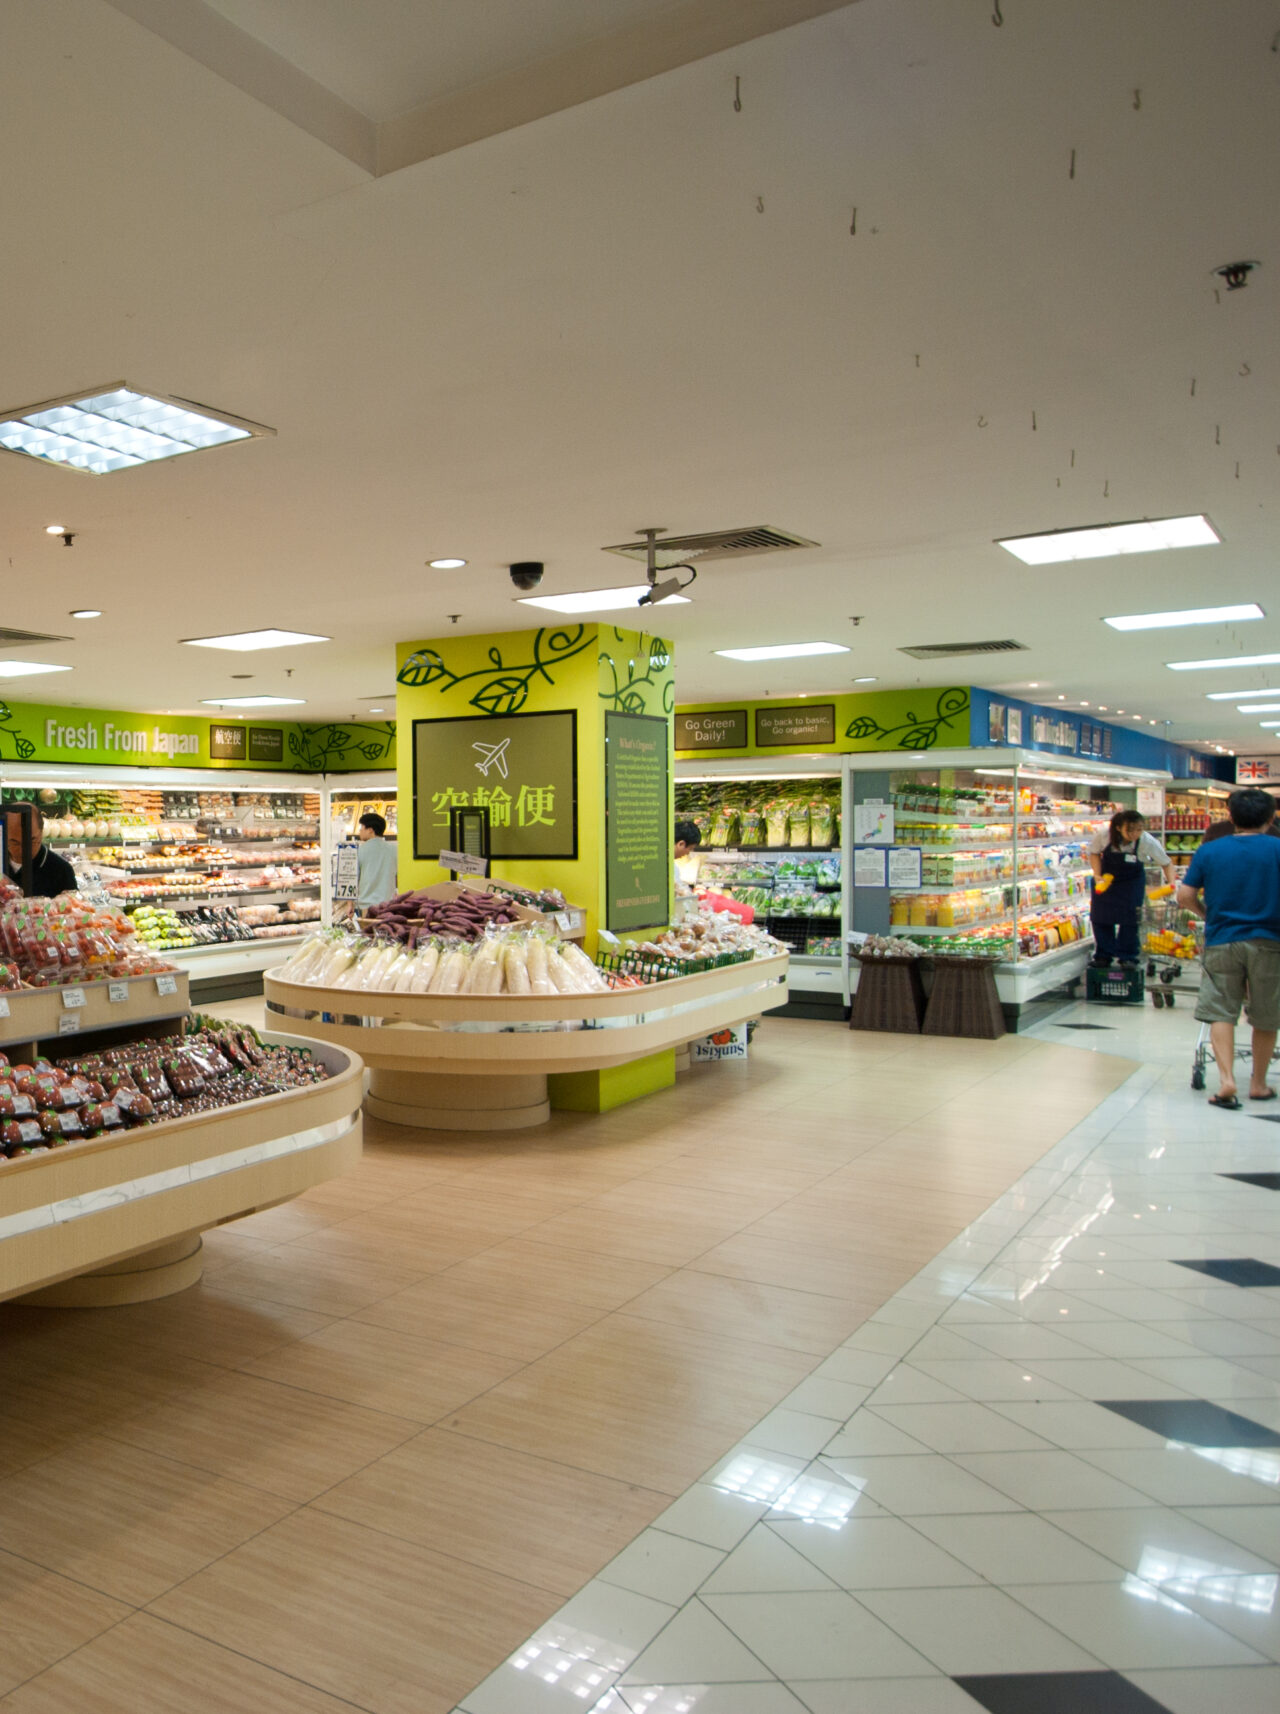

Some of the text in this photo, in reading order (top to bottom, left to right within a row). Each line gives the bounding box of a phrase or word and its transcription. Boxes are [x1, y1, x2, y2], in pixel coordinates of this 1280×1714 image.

[685, 718, 736, 730] Go Green
[761, 718, 772, 727] Go
[774, 717, 793, 726] back
[795, 717, 803, 725] to
[695, 730, 726, 743] Daily!
[772, 725, 818, 735] Go organic!
[45, 719, 199, 759] Fresh From Japan
[431, 784, 556, 828] 空輸便
[695, 1042, 745, 1060] Sunkist
